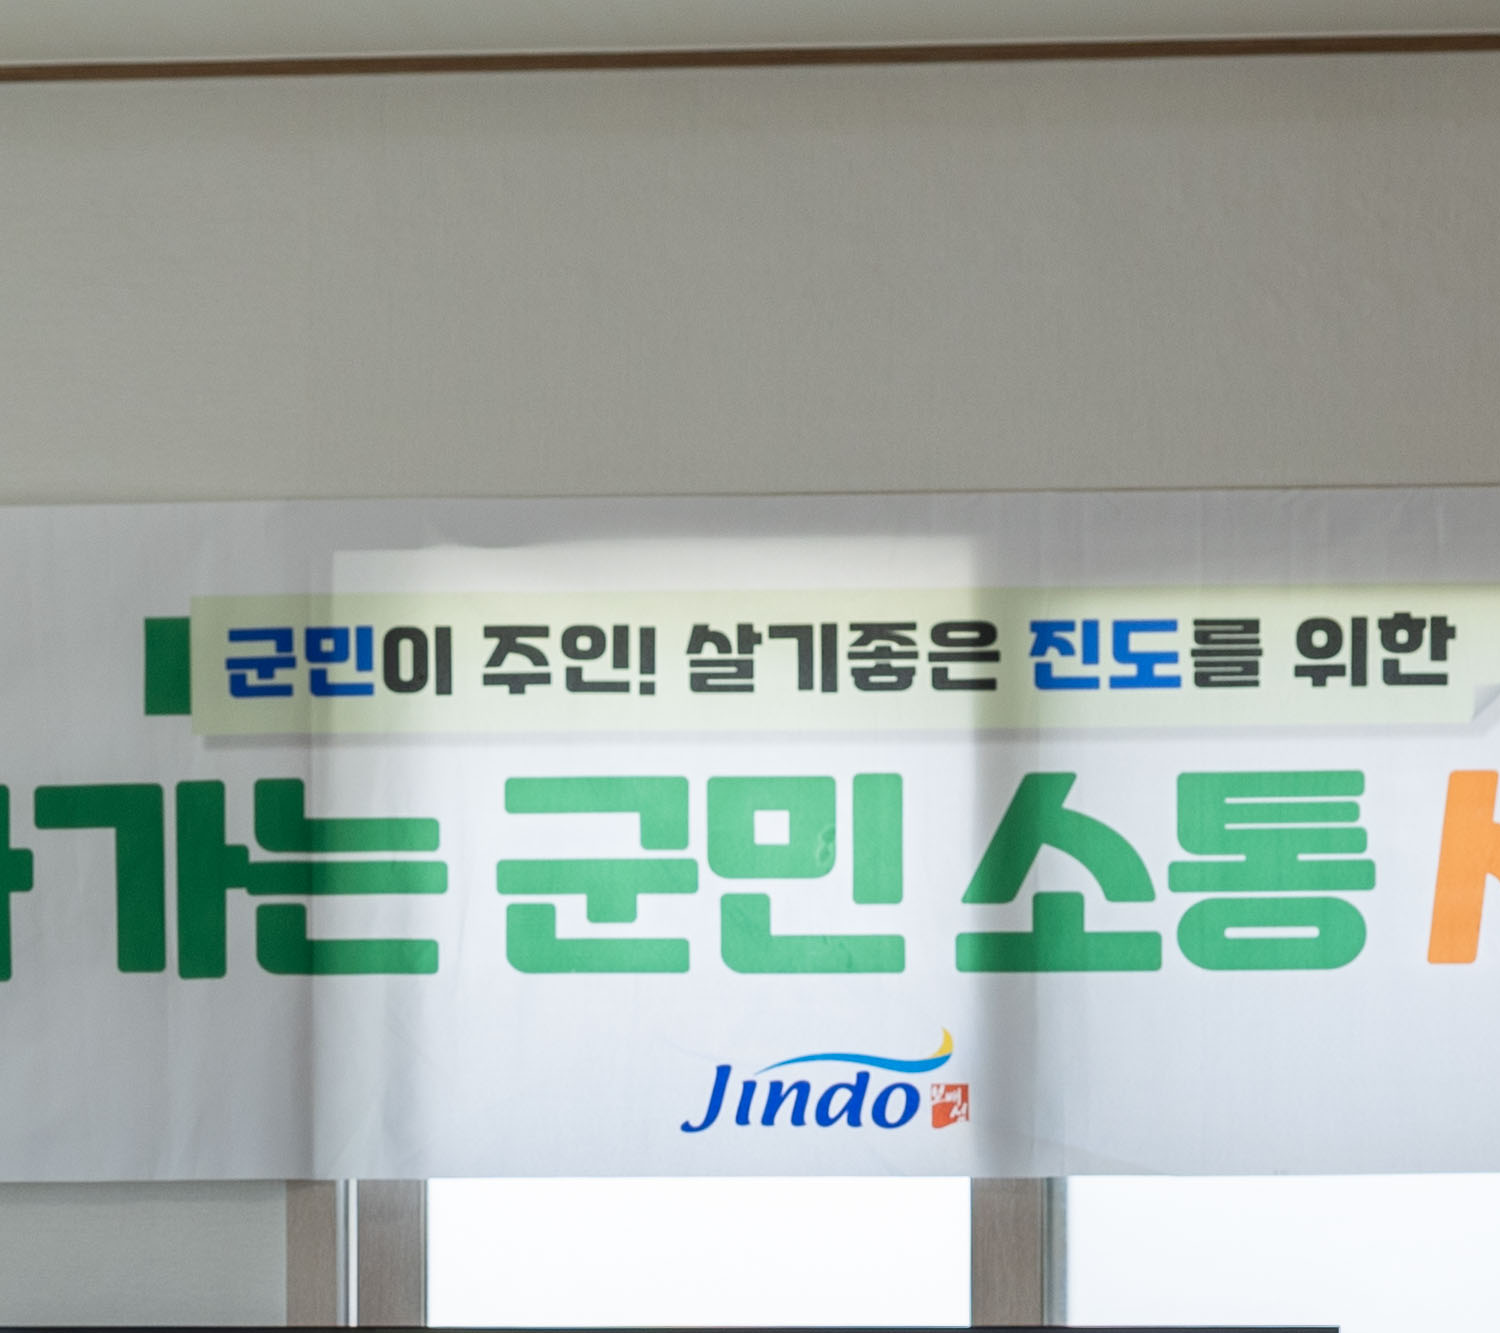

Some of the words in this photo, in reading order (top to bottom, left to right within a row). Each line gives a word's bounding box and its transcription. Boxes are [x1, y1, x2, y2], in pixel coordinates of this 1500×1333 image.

[224, 624, 454, 698] 군민이
[481, 623, 656, 697] 주인!
[685, 619, 1001, 694] 살기좋은
[1028, 617, 1264, 691] 진도를
[1293, 611, 1457, 687] 위한
[495, 771, 908, 975] 군민
[954, 768, 1377, 973] 소통
[679, 1062, 921, 1133] Jindo
